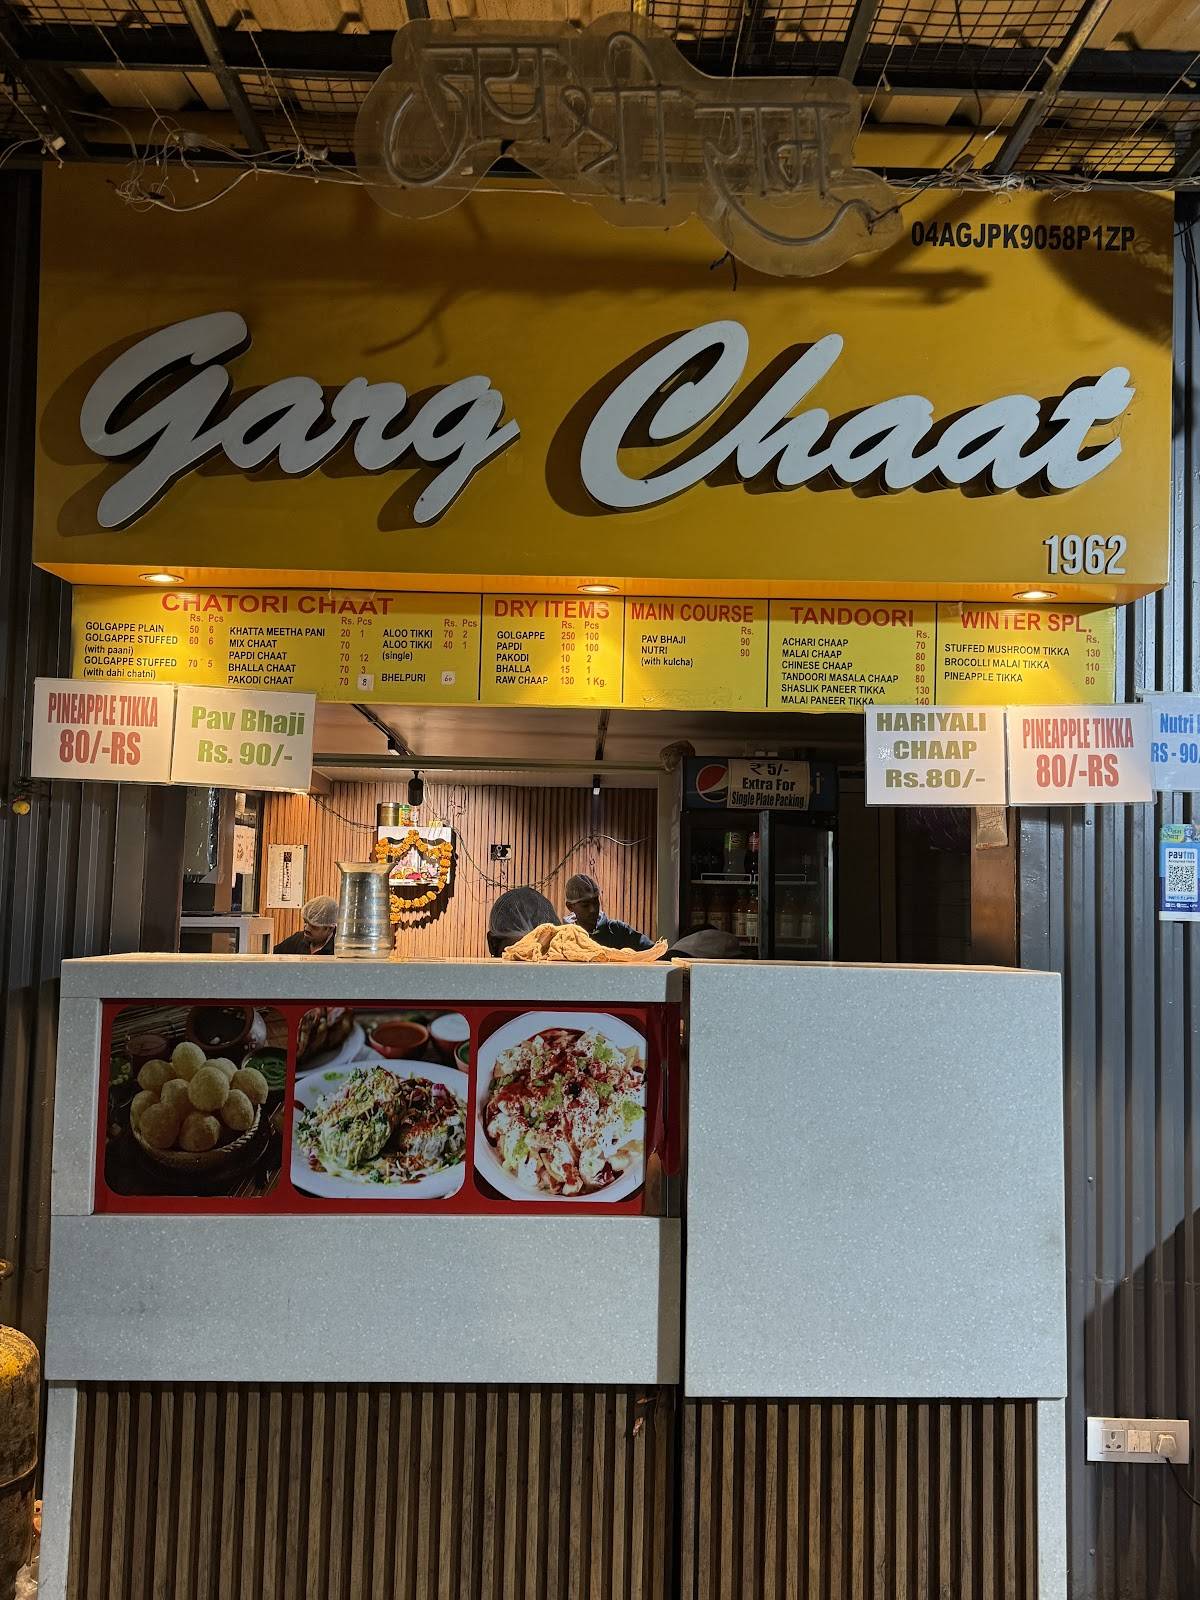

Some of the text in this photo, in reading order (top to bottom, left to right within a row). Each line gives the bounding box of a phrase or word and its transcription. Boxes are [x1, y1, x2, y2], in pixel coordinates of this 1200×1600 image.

[911, 221, 1136, 251] 04AGJPK9058P1ZP
[79, 311, 1136, 529] Garg Chaat
[1043, 534, 1127, 575] 1962
[162, 592, 394, 616] CHATORI CHAAT
[494, 600, 610, 620] DRY ITEMS
[190, 614, 224, 623] Rs. Pcs
[631, 603, 754, 623] MAIN COURSE
[790, 607, 914, 627] TANDOORI
[342, 616, 372, 626] Rs. Pcs
[444, 618, 478, 628] Rs. Pcs
[561, 620, 599, 630] Rs. Pcs
[961, 611, 1092, 633] WINTER SPL.
[86, 622, 136, 632] GOLGAPPE
[138, 624, 164, 633] PLAIN
[208, 626, 214, 634] 6
[230, 627, 364, 638] KHATTA MEETHA PANI 20 1
[383, 629, 468, 638] ALOO TIKKI 70 2
[740, 626, 754, 636] Rs.
[86, 633, 135, 643] GOLGAPPE
[138, 634, 178, 644] STUFFED
[208, 637, 214, 645] 6
[496, 631, 599, 641] GOLGAPPE 250 100
[642, 635, 750, 646] PAV BHAJI 90
[916, 630, 930, 639] Rs.
[1086, 635, 1100, 644] Rs.
[229, 639, 350, 650] MIX CHAAT 70
[382, 640, 467, 649] ALOO TIKKI 40 1
[496, 642, 599, 652] PAPDI 100 100
[782, 638, 926, 650] ACHARI CHAAP 70
[84, 645, 134, 656] (with paani)
[228, 651, 369, 662] PAPDI CHAAT 70 12
[382, 651, 413, 662] (single)
[641, 646, 750, 658] NUTRI 90
[782, 649, 926, 661] MALAI CHAAP 80
[944, 644, 1100, 658] STUFFED MUSHROOM TIKKA 130
[84, 656, 212, 668] GOLGAPPE STUFFED 70 5
[496, 653, 592, 663] PAKODI 10 2
[641, 657, 694, 668] (with kulcha)
[228, 663, 366, 674] BHALLA CHAAT 70 3
[496, 664, 591, 674] BHALLA 15 1
[782, 661, 926, 672] CHINESE CHAAP 80
[944, 658, 1100, 672] BROCOLLI MALAI TIKKA 110
[84, 667, 104, 678] (with
[127, 669, 156, 680] chatni)
[382, 673, 426, 682] BHELPURI
[782, 672, 925, 684] TANDOORI MASALA CHAAP 80
[944, 672, 1095, 685] PINEAPPLE TIKKA 80
[228, 676, 261, 685] PAKODI
[263, 676, 294, 686] CHAAT
[339, 678, 349, 686] 70
[496, 676, 607, 688] RAW CHAAP 130 1 Kg.
[782, 684, 930, 695] SHASLIK PANEER TIKKA 130
[781, 695, 930, 706] MALAI PANEER TIKKA 140
[48, 692, 158, 728] PINEAPPLE TIKKA
[191, 706, 305, 736] Pav Bhaji
[876, 712, 987, 732] HARIYALI
[1160, 713, 1194, 734] Nutri
[1022, 718, 1134, 749] PINEAPPLE TIKKA
[59, 729, 141, 765] 80/-RS
[893, 740, 977, 760] CHAAP
[1151, 742, 1168, 762] RS
[197, 740, 293, 767] Rs. 90/-
[749, 762, 789, 776] ₹ 5/-
[1036, 754, 1120, 788] 80/-RS
[742, 777, 796, 792] Extra For
[886, 768, 986, 789] Rs.80/-
[732, 792, 805, 808] Single Plate Packing
